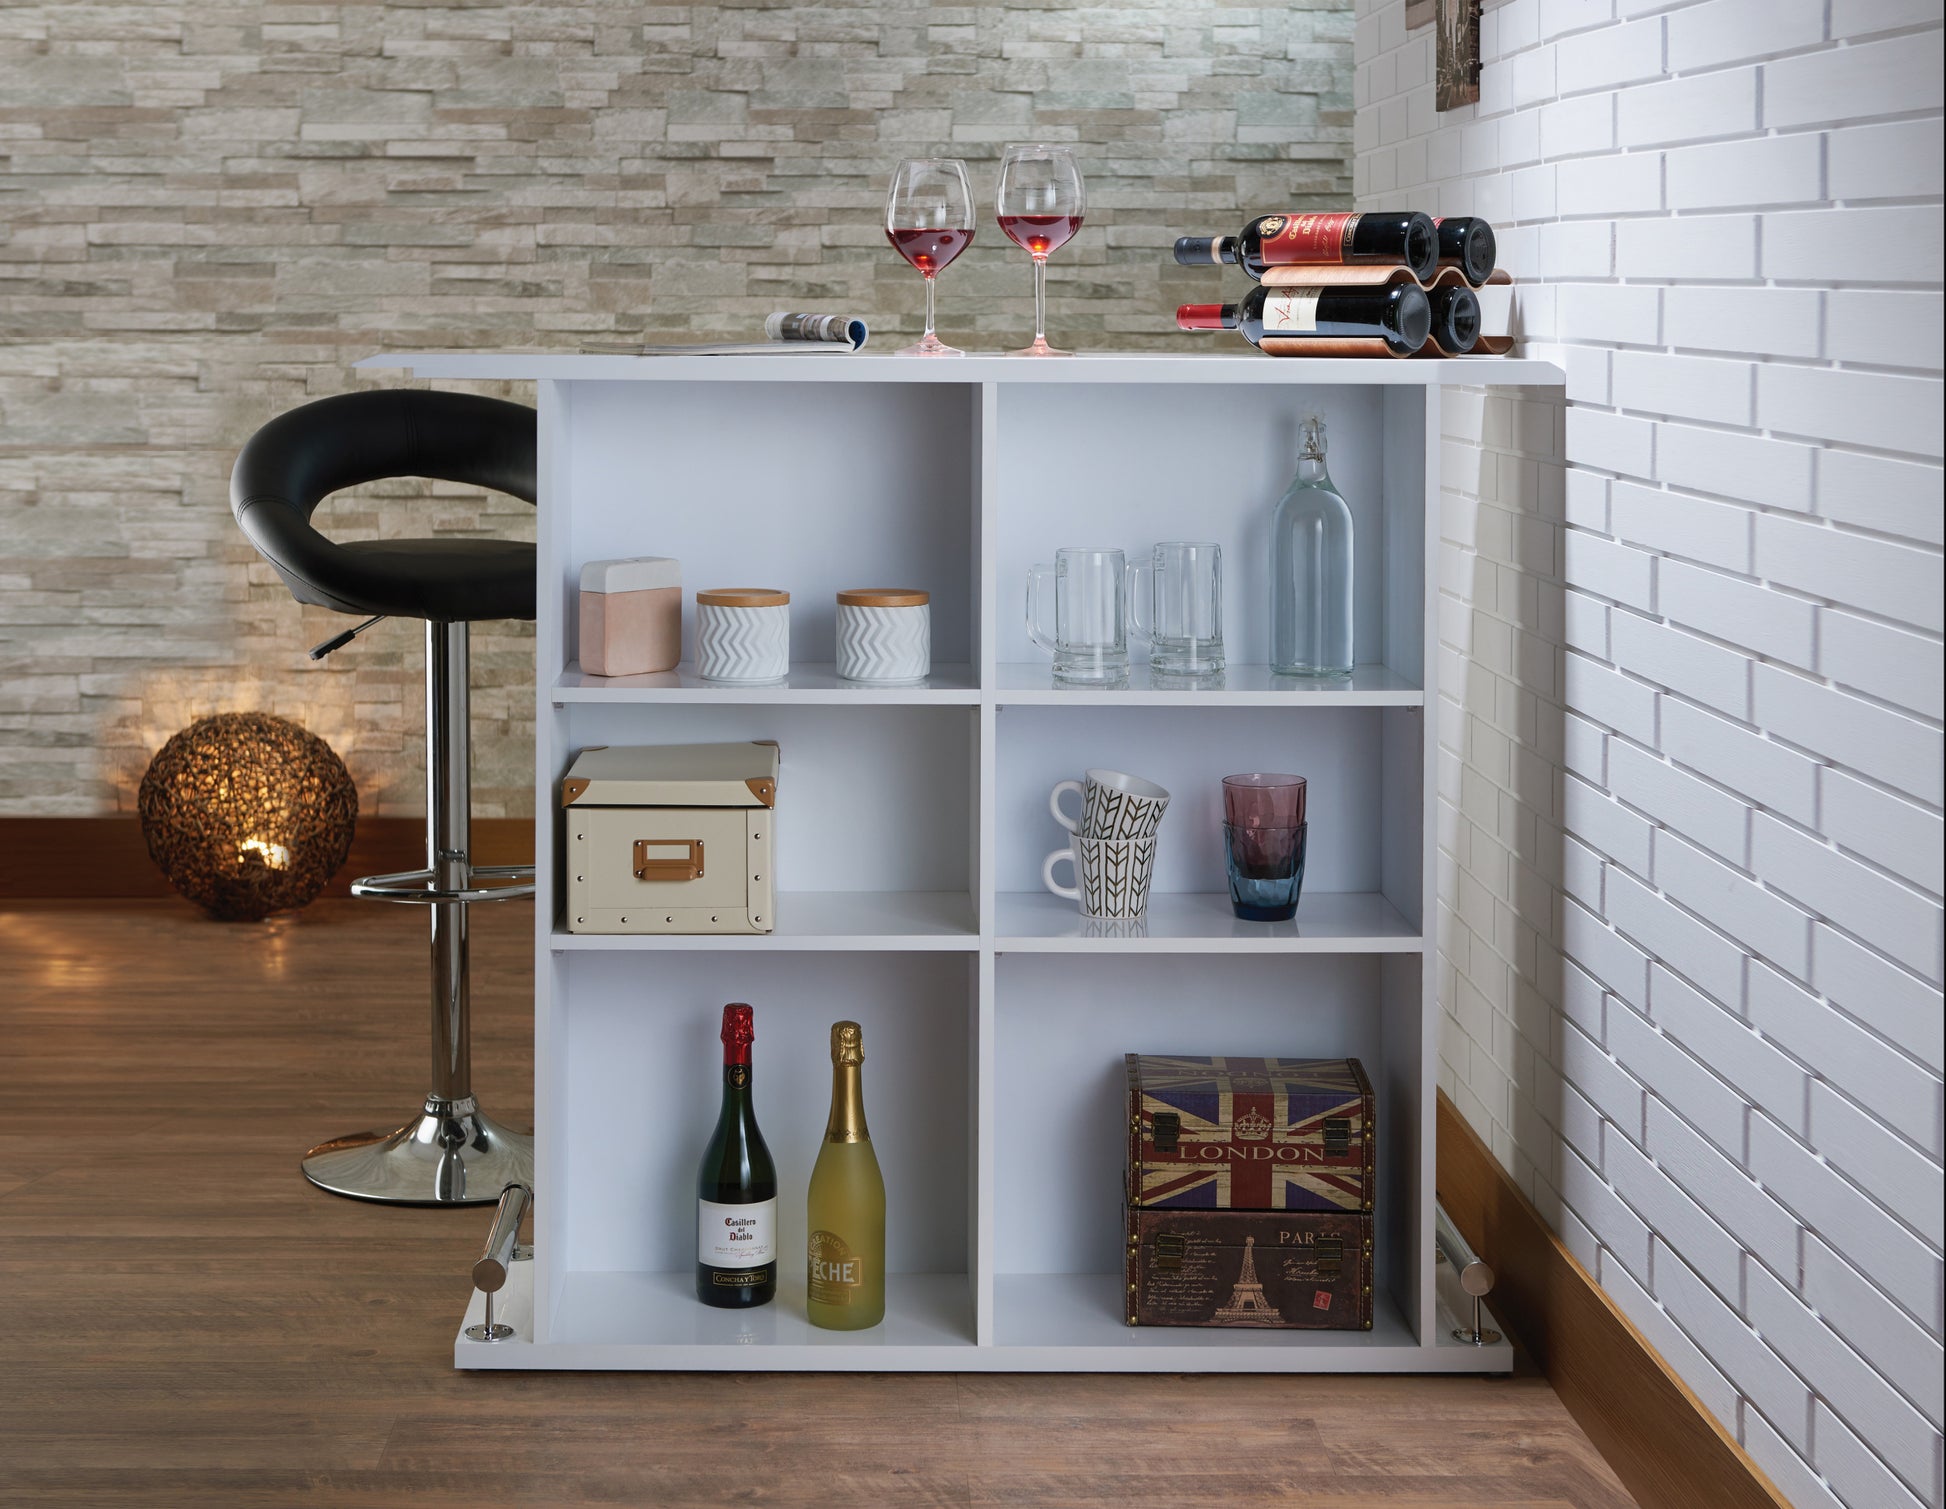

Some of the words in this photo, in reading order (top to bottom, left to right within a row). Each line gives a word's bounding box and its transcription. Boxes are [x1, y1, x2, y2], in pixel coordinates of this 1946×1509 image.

[1180, 1146, 1324, 1161] LONDON
[725, 1217, 756, 1227] Casillero
[729, 1232, 753, 1241] Diablo
